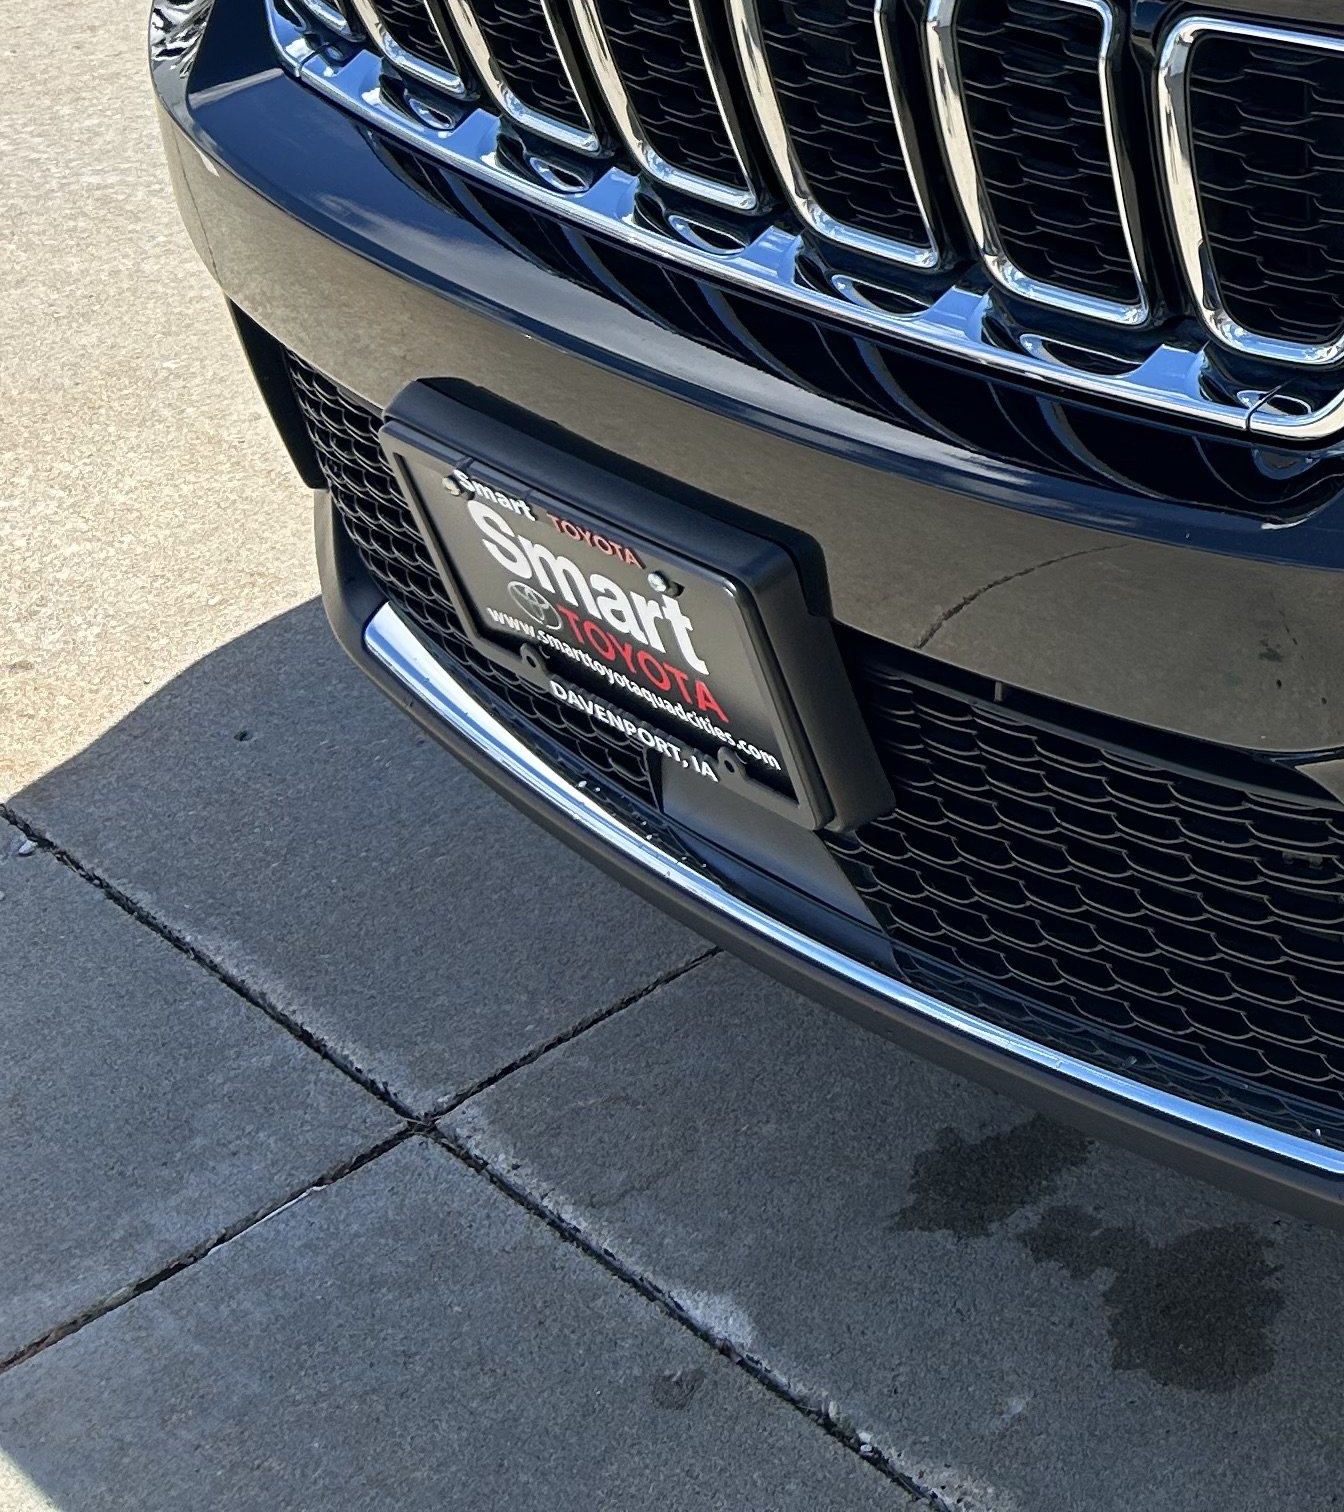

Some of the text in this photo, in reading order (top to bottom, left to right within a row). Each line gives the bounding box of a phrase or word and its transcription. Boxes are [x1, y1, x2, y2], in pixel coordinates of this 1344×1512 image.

[453, 468, 646, 570] Smart TOYOTA
[467, 499, 710, 676] Smart
[487, 606, 782, 772] www.smarttoyotaquadcities.com
[557, 603, 729, 724] TOYOTA
[690, 755, 719, 784] IA
